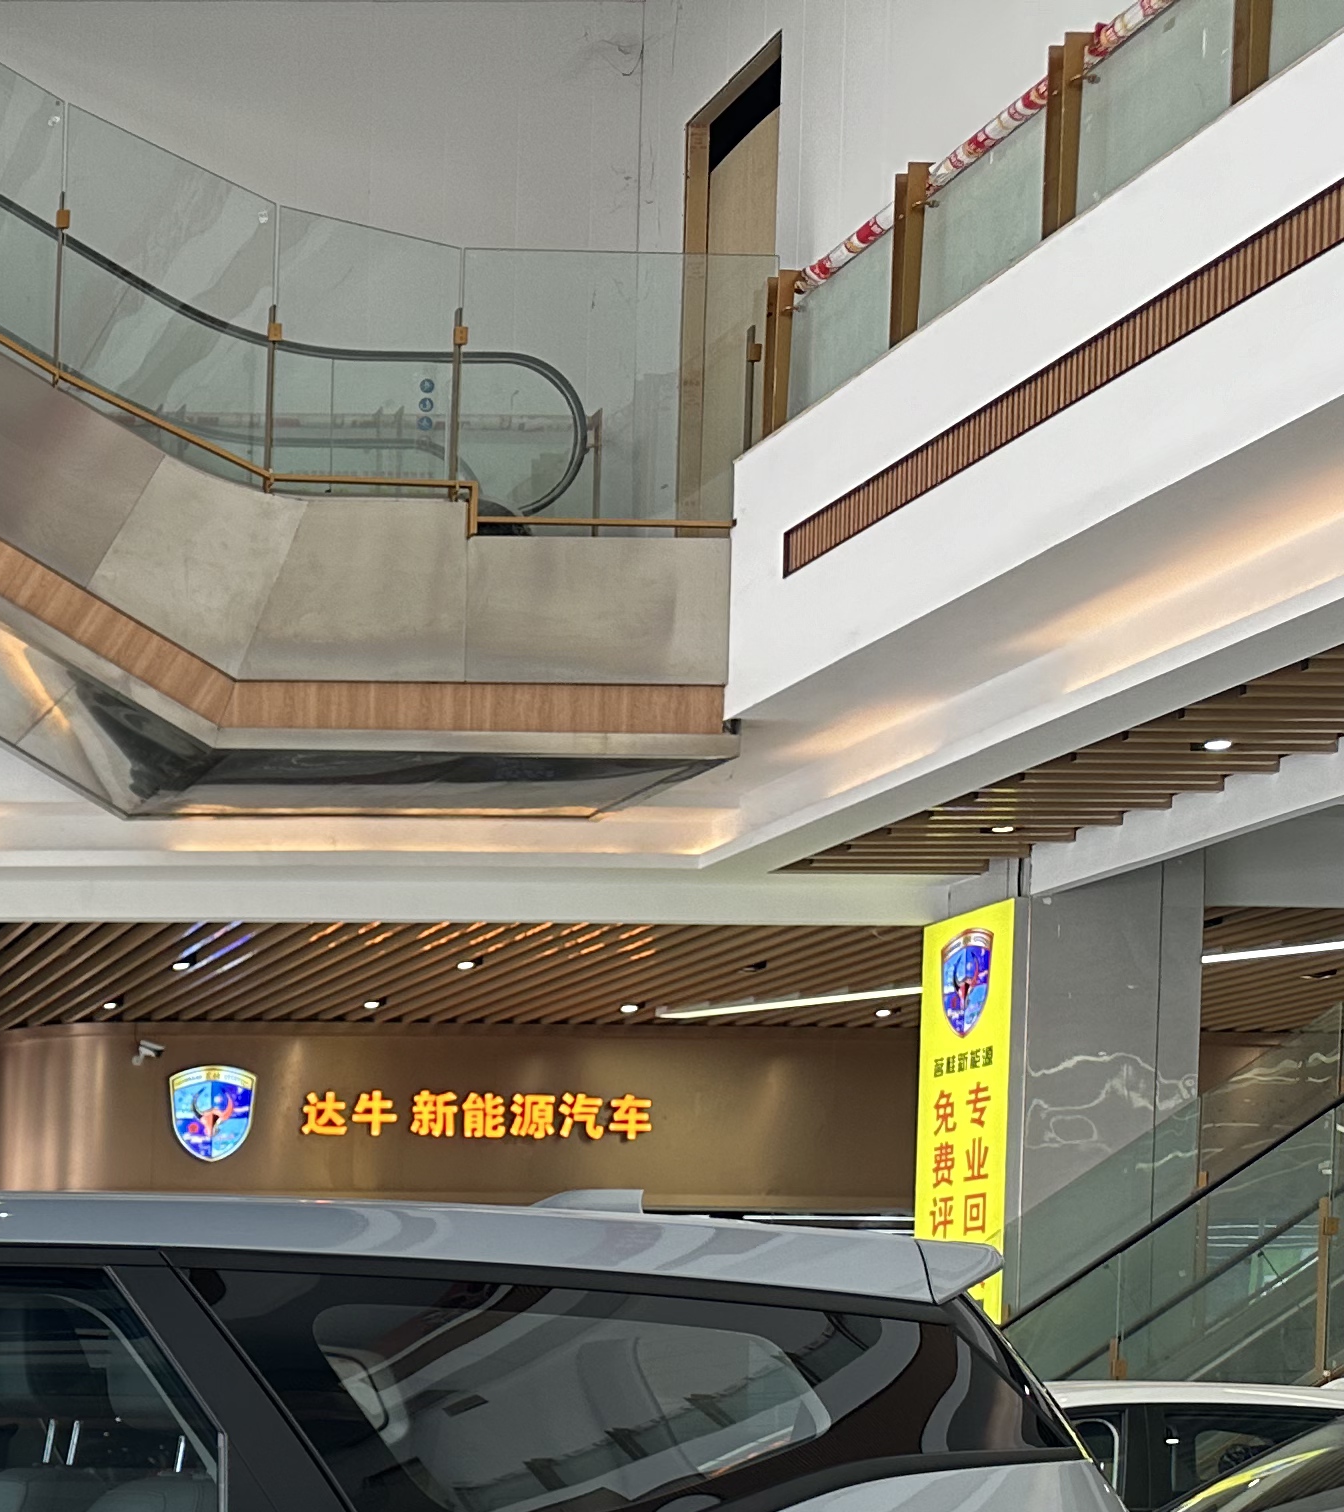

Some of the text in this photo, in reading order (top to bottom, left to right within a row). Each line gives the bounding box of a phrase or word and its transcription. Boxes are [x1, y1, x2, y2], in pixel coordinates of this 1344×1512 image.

[301, 1090, 653, 1140] 达牛 新能源汽车
[929, 1089, 958, 1239] 免费评
[963, 1081, 992, 1289] 专业回
